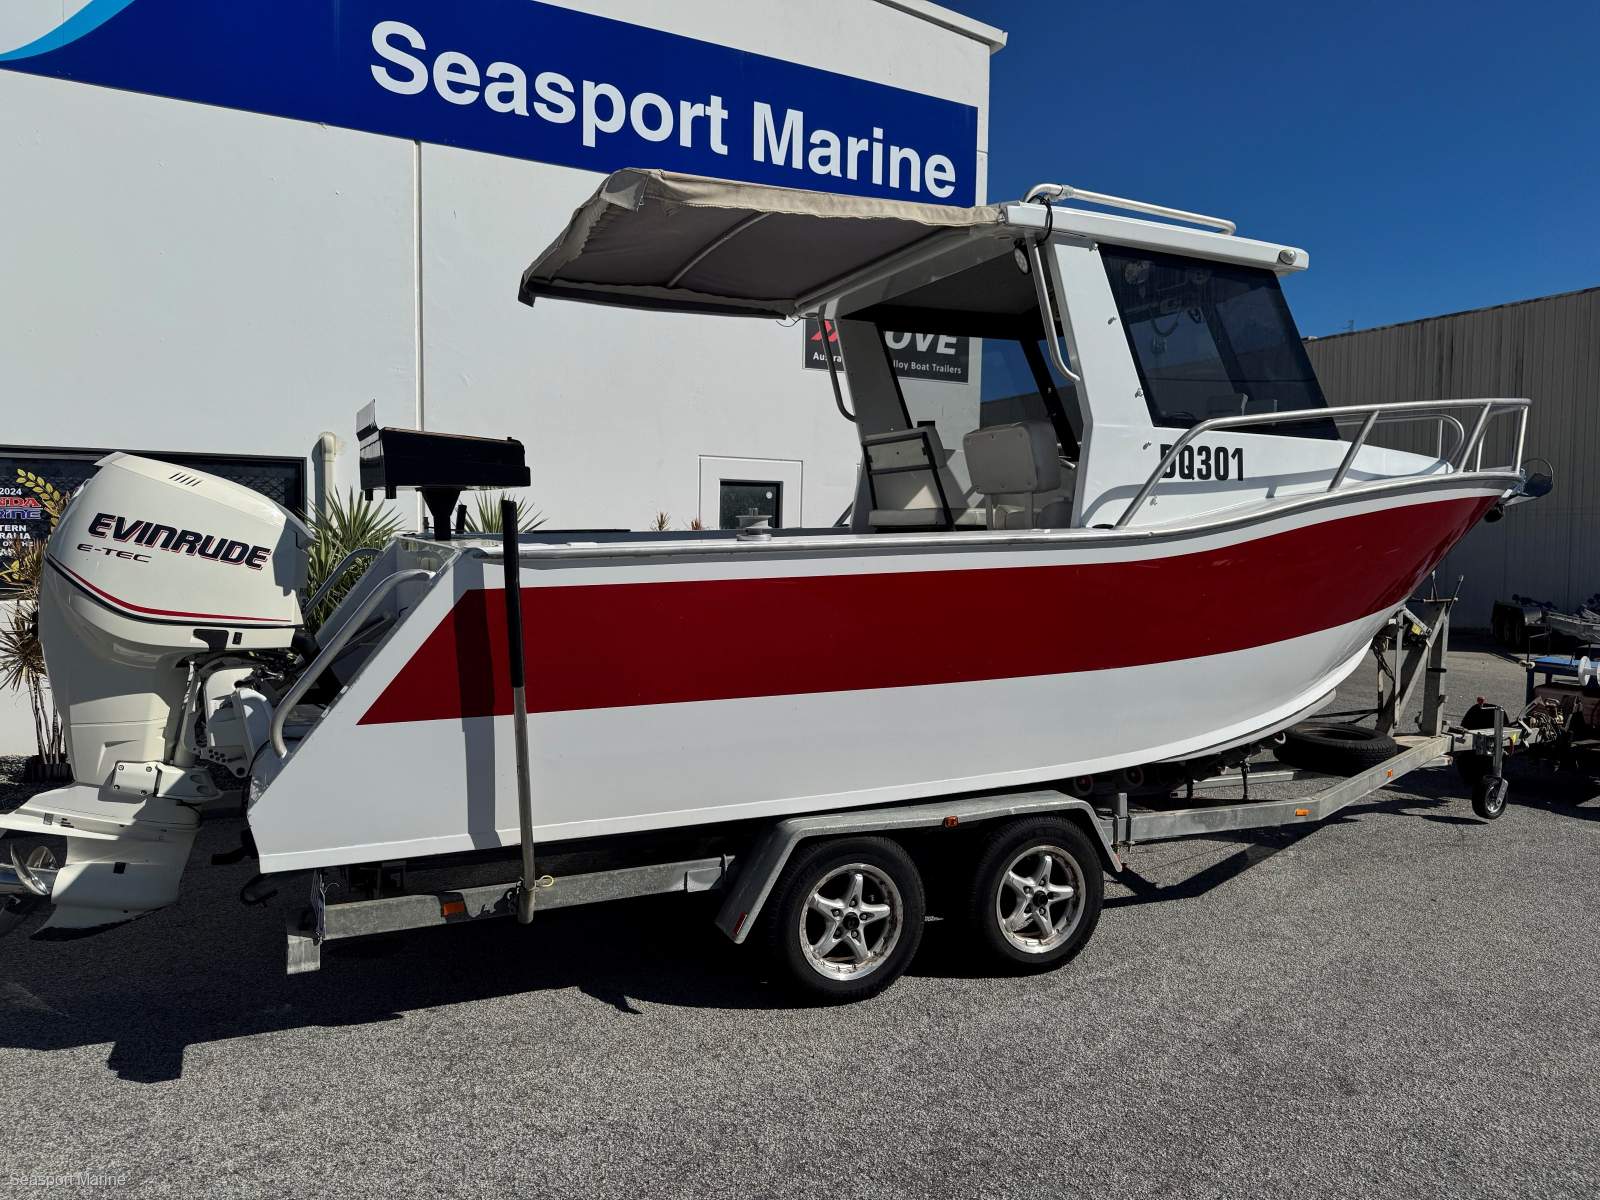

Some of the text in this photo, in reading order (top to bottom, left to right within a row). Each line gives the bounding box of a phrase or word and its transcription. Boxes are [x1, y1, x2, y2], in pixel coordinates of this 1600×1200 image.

[371, 20, 957, 199] Seasport Marine
[885, 331, 957, 355] OVE
[893, 360, 909, 371] lloy
[911, 361, 930, 371] Boat
[932, 363, 962, 374] Trailers
[77, 543, 153, 563] E-TEC
[88, 512, 272, 571] EVINRUDE
